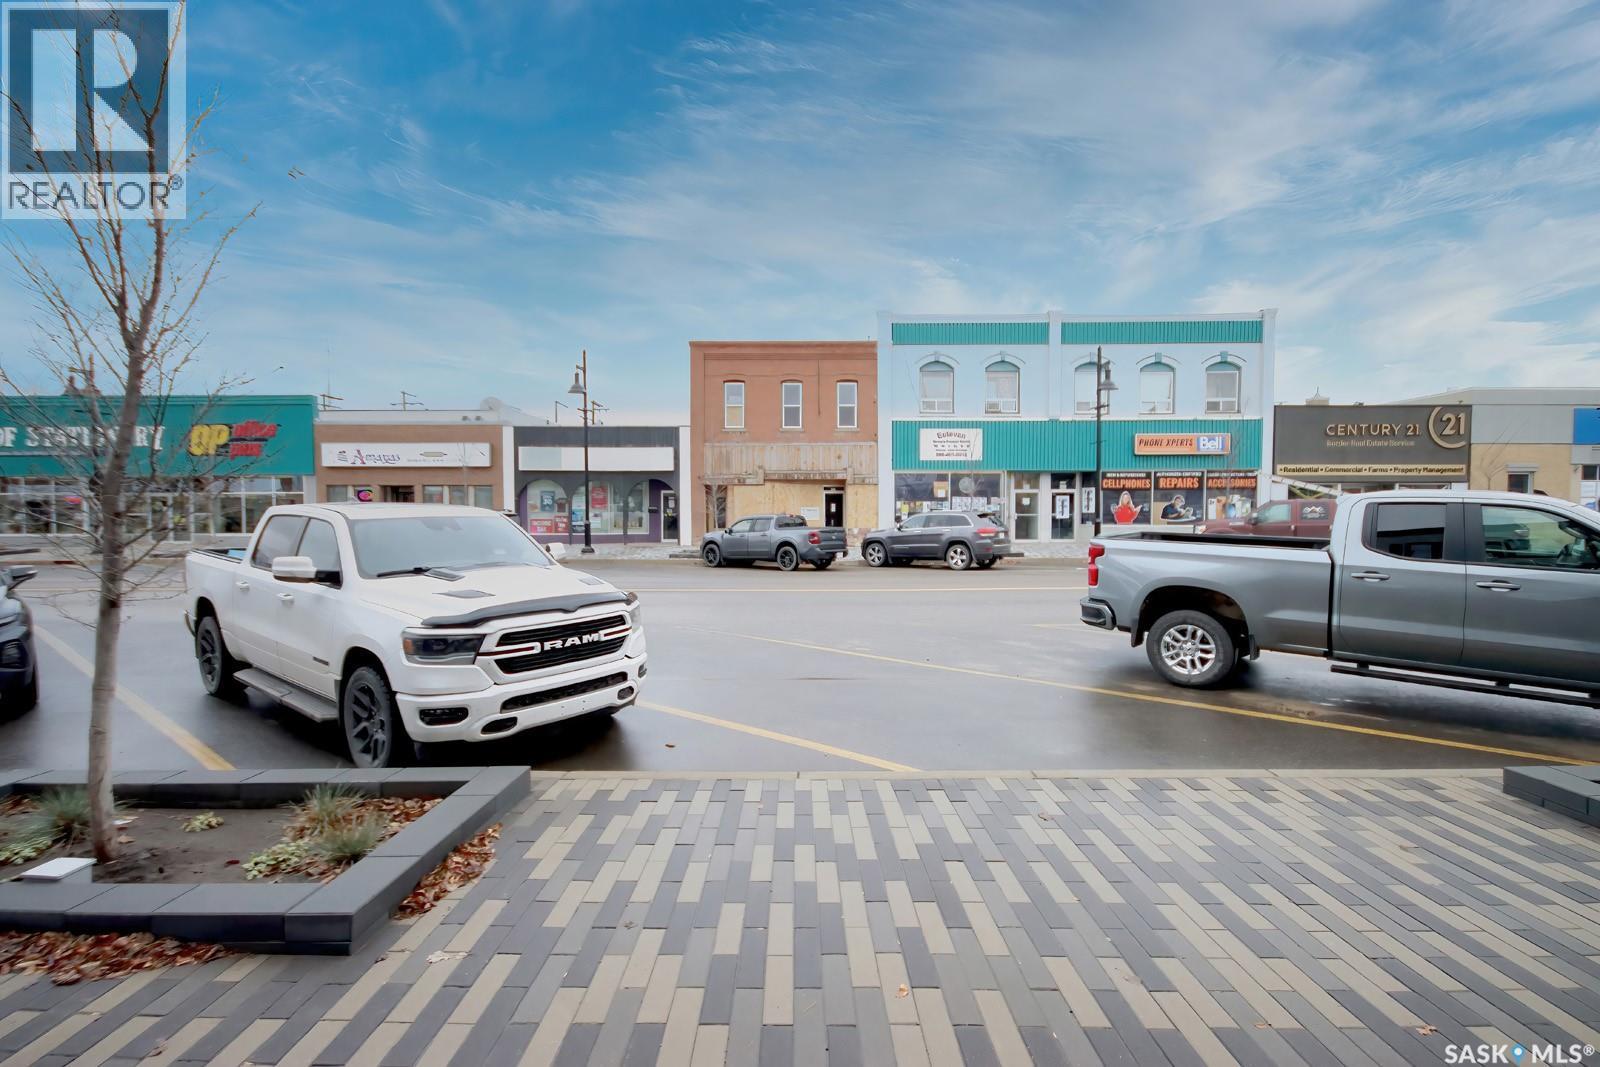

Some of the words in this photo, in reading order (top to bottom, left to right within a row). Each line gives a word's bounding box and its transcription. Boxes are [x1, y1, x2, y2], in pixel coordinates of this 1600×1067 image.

[1326, 424, 1401, 436] CENTURY
[1406, 424, 1420, 436] 21
[1199, 436, 1223, 449] Bell
[1393, 466, 1421, 474] Property
[1422, 466, 1464, 474] Management
[1102, 479, 1151, 489] CELLPHONES
[1159, 477, 1199, 489] REPAIRS
[543, 633, 599, 651] RAM
